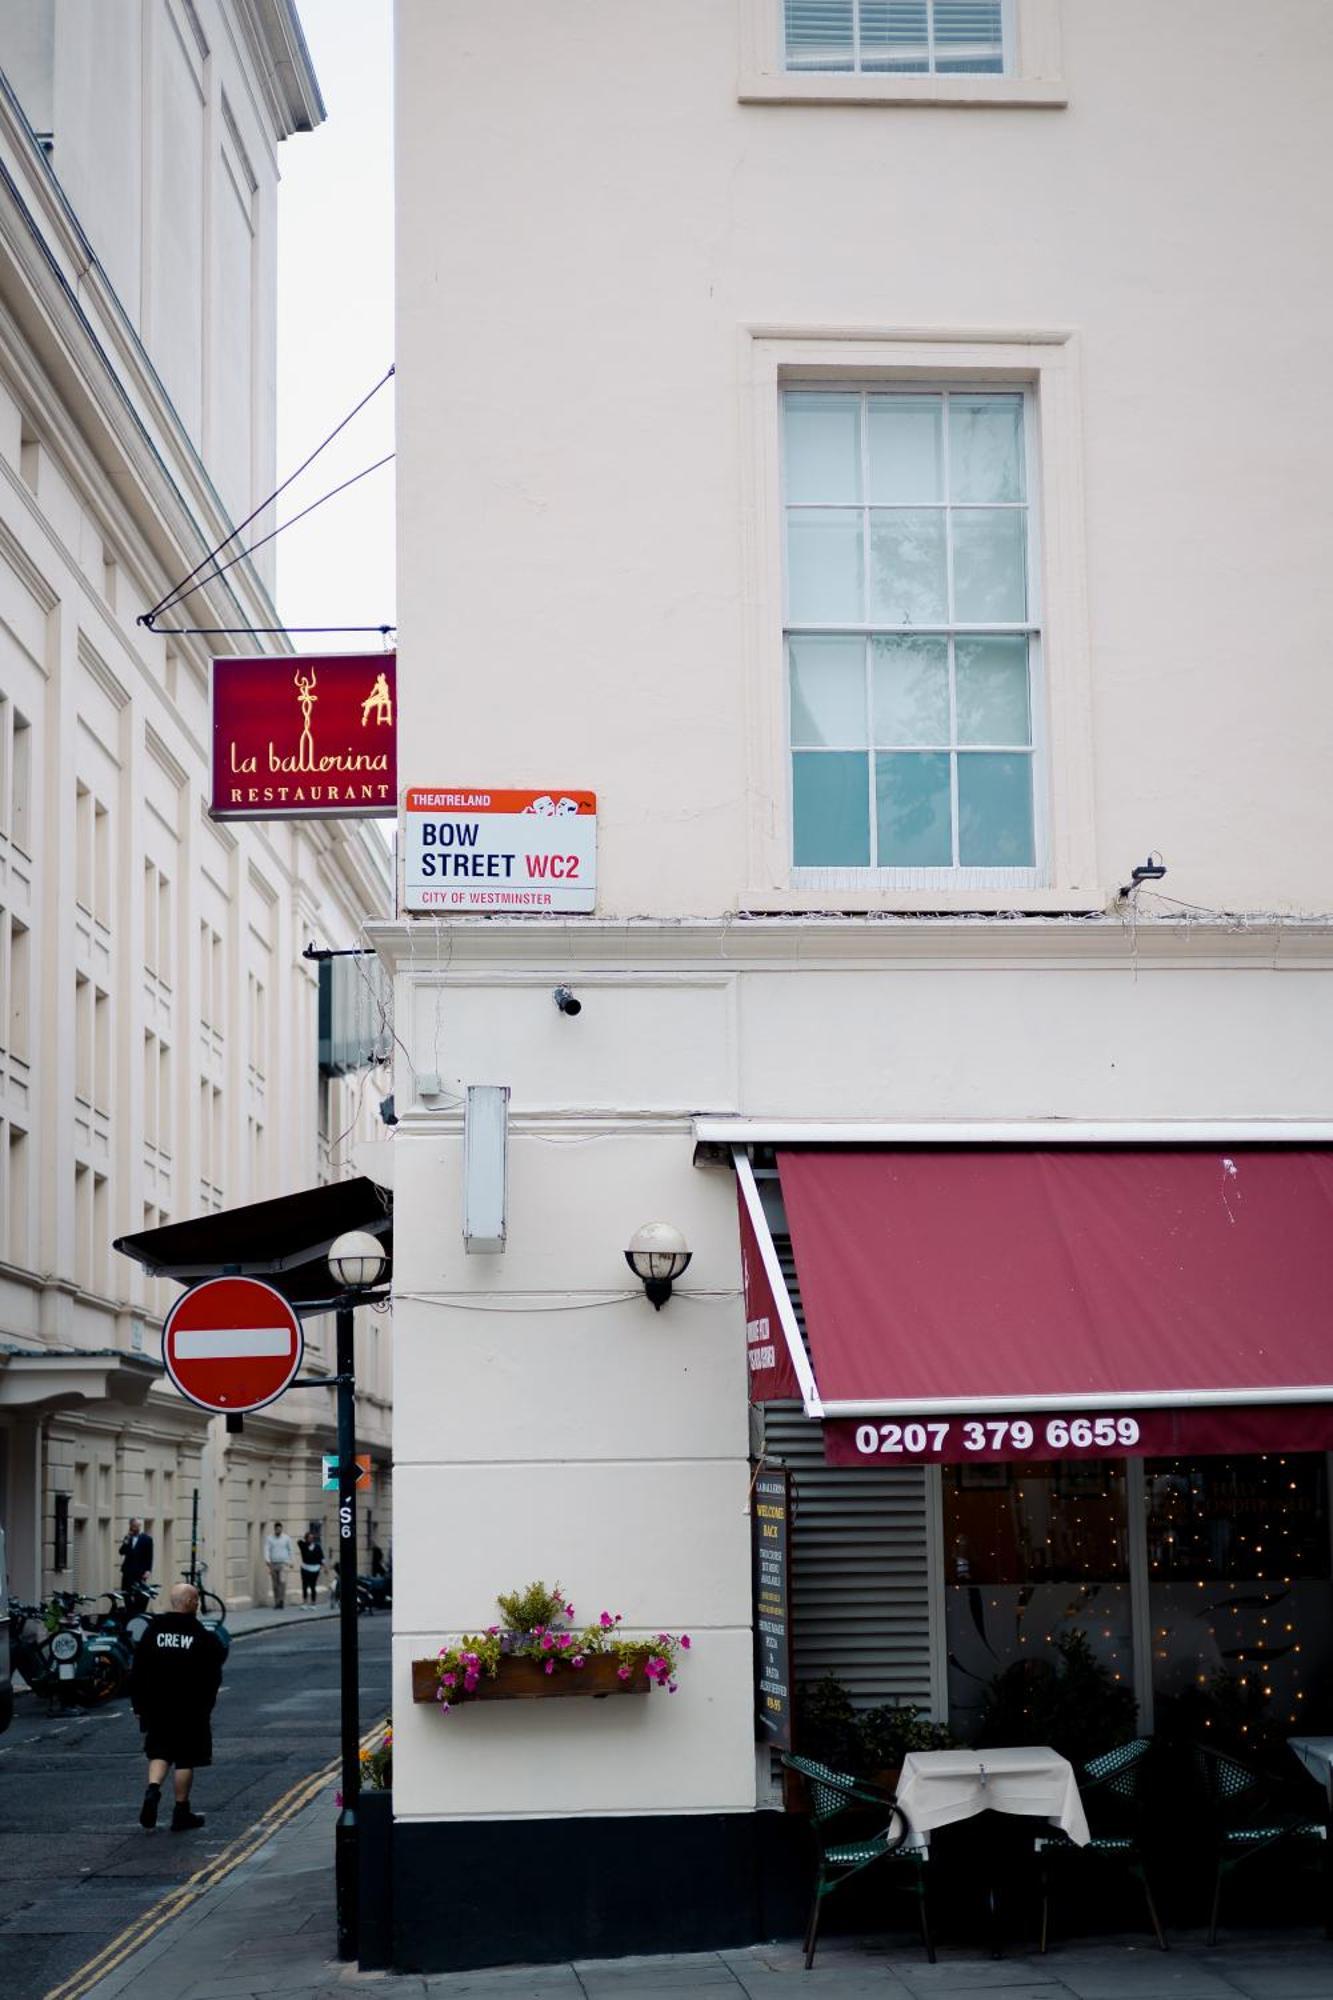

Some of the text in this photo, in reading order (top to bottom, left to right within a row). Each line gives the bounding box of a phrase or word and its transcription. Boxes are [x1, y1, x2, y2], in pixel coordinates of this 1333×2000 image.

[231, 733, 388, 773] la ballerina
[231, 784, 389, 802] RESTAURANT
[412, 794, 491, 806] THEATRELAND
[422, 823, 479, 847] BOW
[422, 853, 580, 878] STREET WC2
[422, 891, 551, 905] CITY OF WESTMINSTER
[855, 1417, 1140, 1454] 0207 379 6659
[757, 1504, 784, 1519] WELCOME
[157, 1633, 194, 1650] CREW
